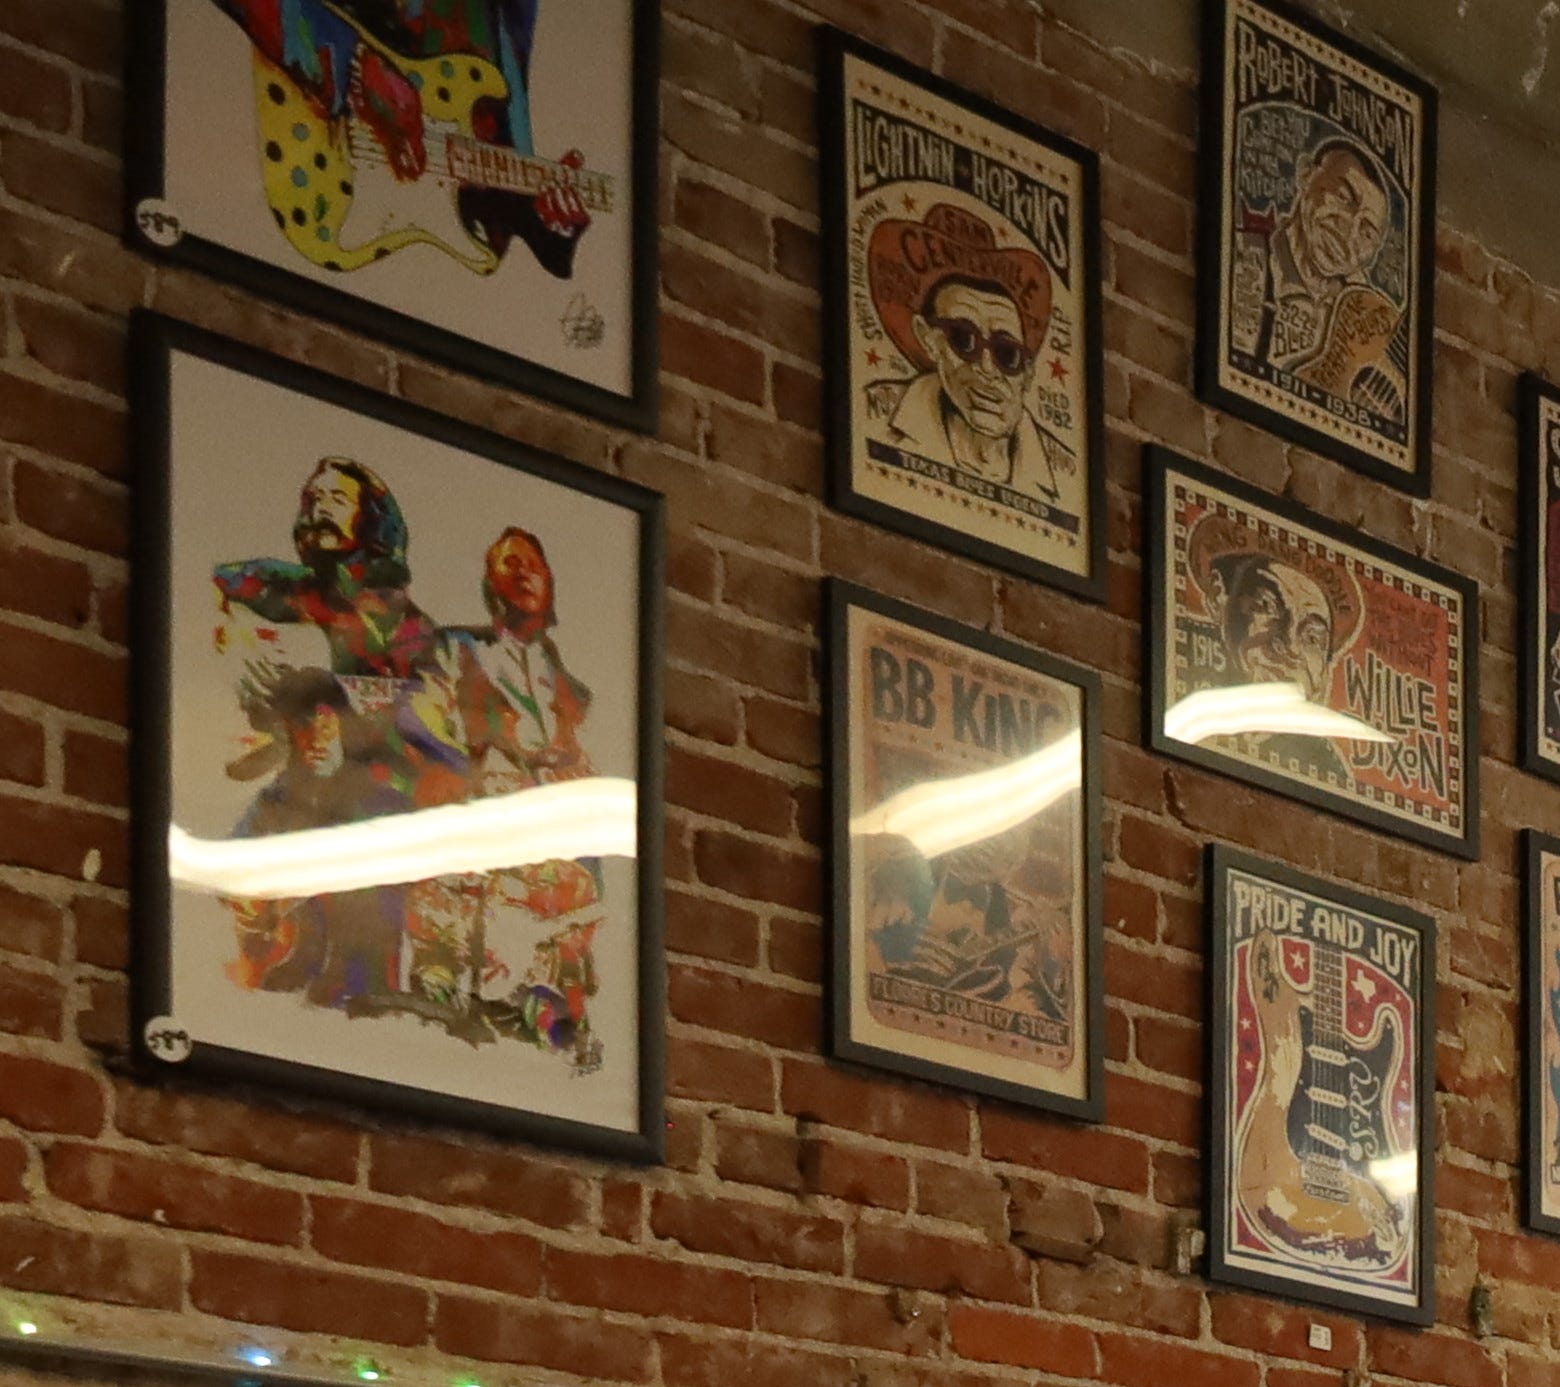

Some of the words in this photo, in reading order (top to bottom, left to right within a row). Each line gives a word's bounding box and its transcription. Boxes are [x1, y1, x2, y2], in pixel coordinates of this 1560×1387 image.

[1237, 20, 1320, 105] ROBERT
[1328, 73, 1413, 192] JOHNSON
[1271, 368, 1308, 399] 1911
[1325, 396, 1373, 428] 1938
[869, 646, 936, 729] BB
[1311, 911, 1365, 950] AND
[1369, 924, 1417, 990] JOY
